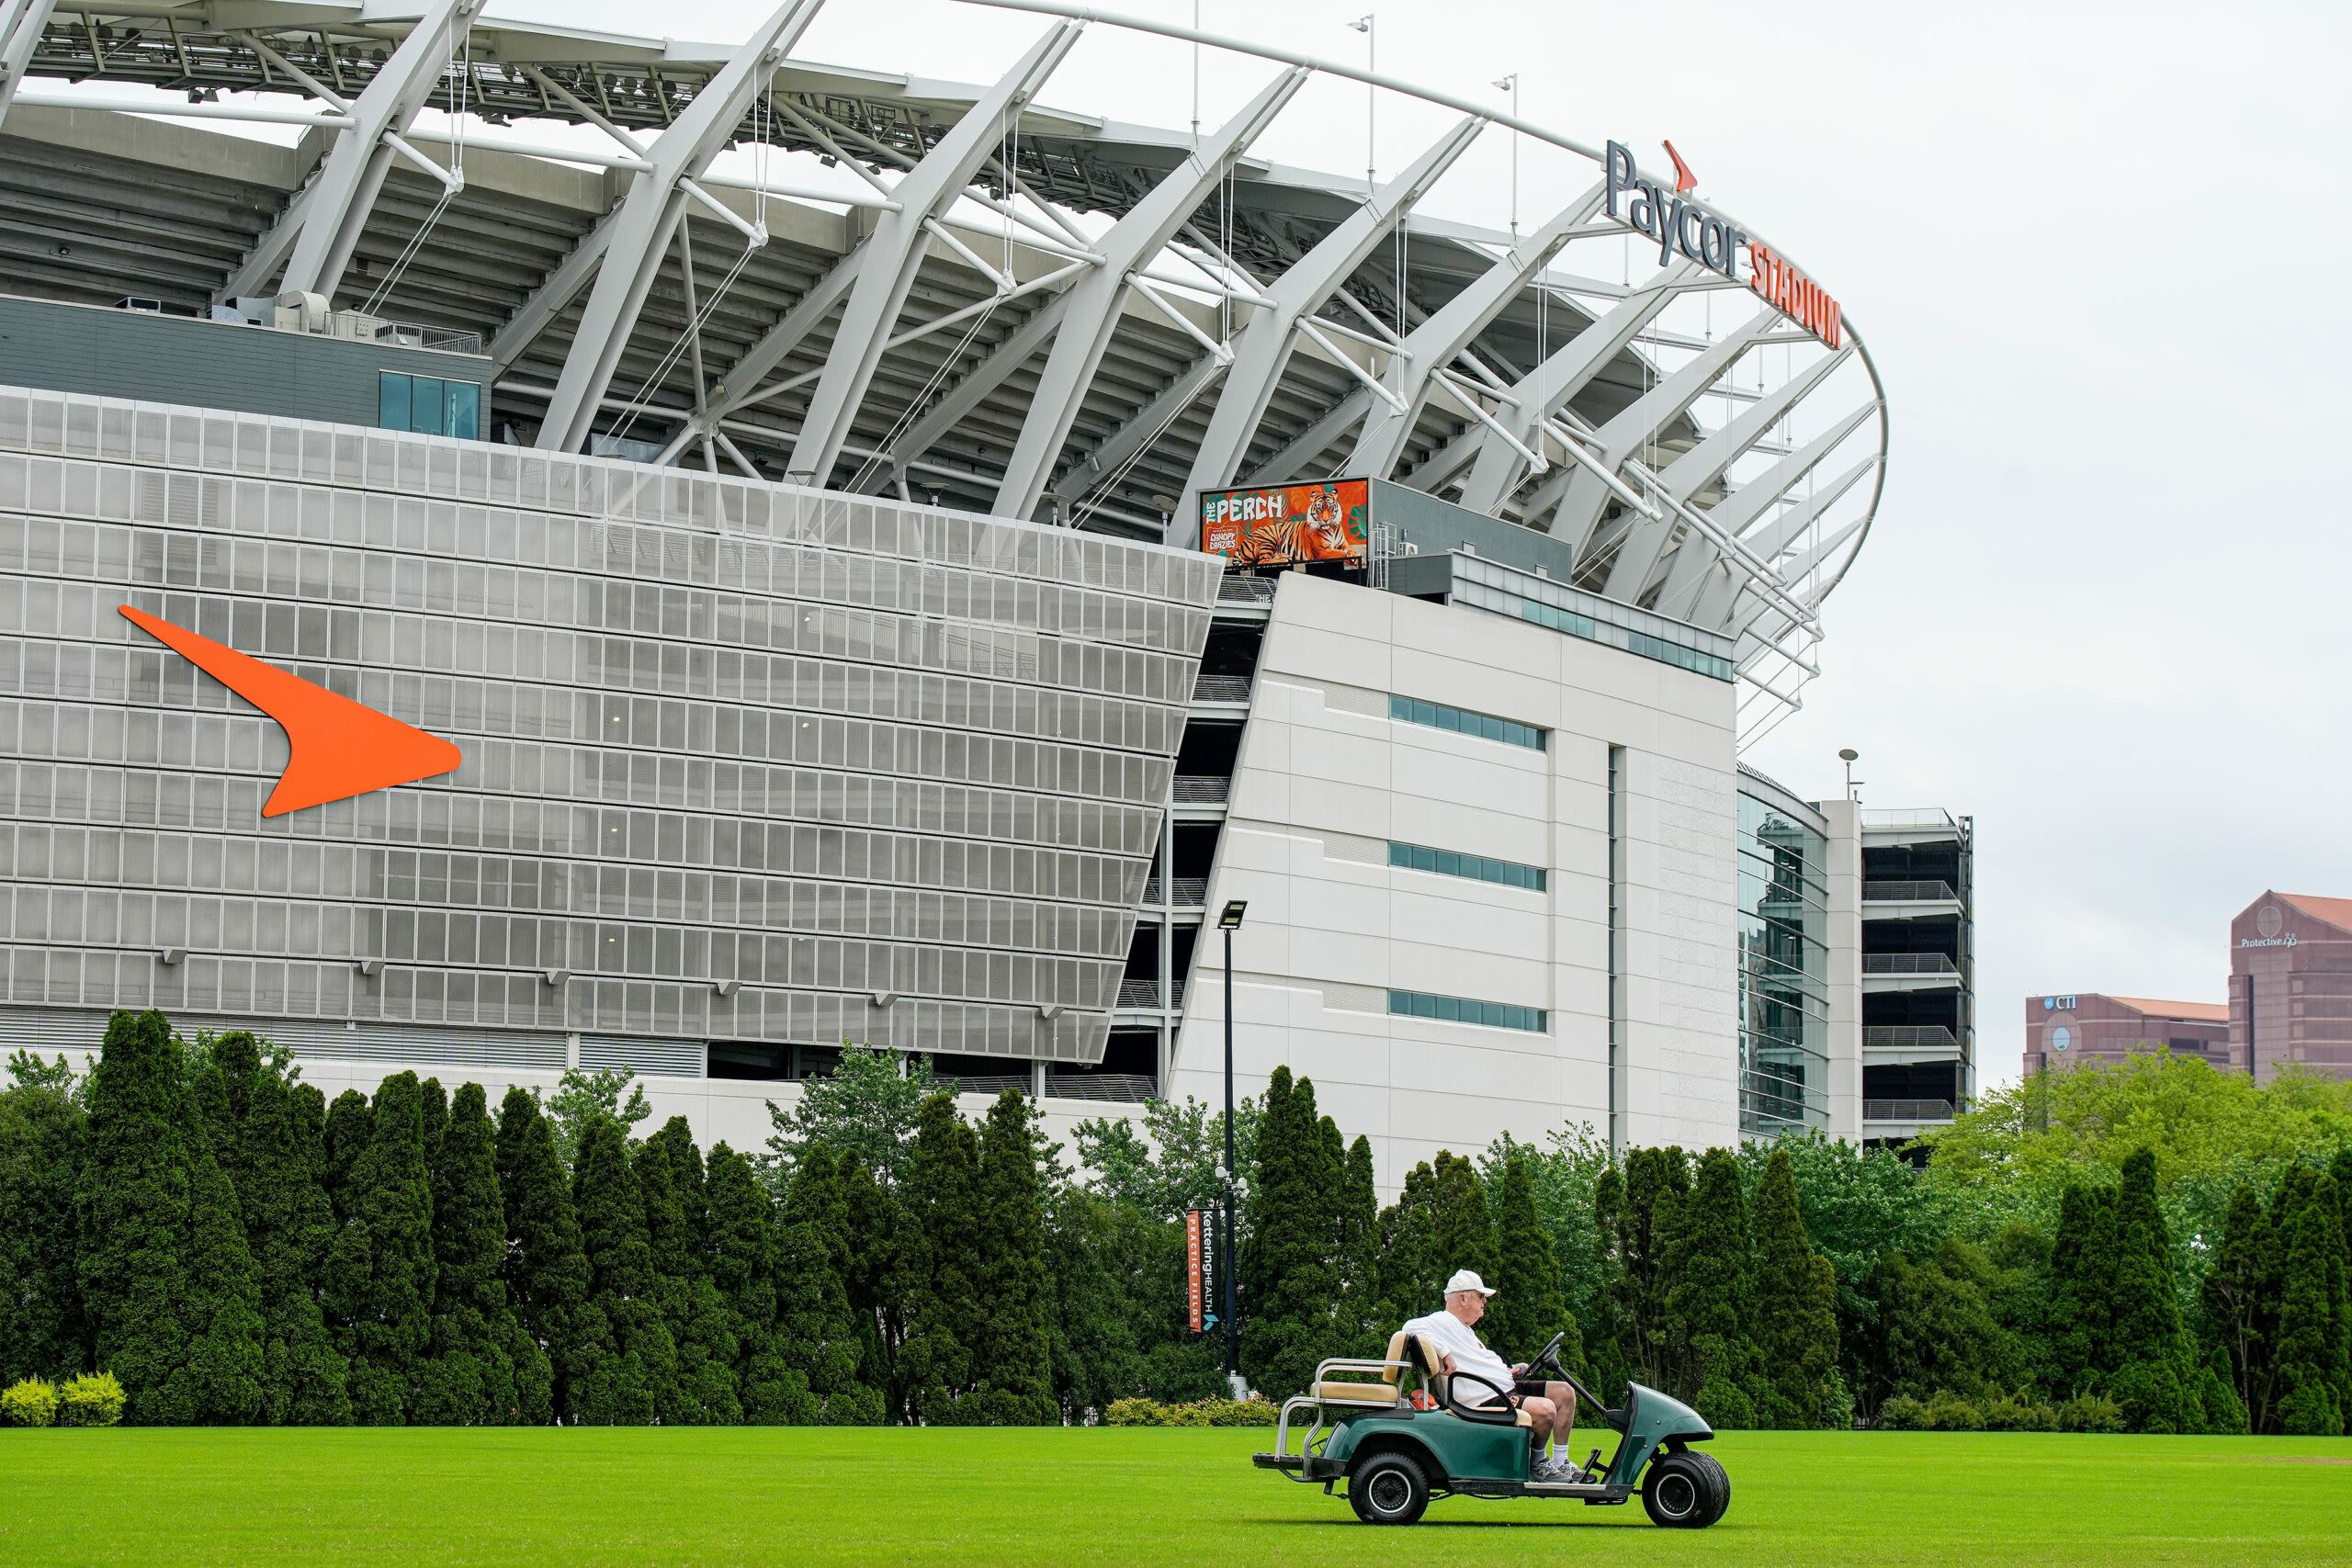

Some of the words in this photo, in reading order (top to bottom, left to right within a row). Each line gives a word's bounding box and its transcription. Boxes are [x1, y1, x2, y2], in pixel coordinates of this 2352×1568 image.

[1607, 139, 1747, 276] Paycor
[1750, 240, 1841, 350] STADIUM
[1205, 502, 1216, 525] THE
[1216, 495, 1283, 524] PERCH
[1209, 540, 1236, 550] CRAZIES
[1210, 533, 1236, 542] CANOPY
[2242, 936, 2282, 948] Protective
[2055, 995, 2076, 1010] CTI
[1190, 1218, 1198, 1277] PRACTICE
